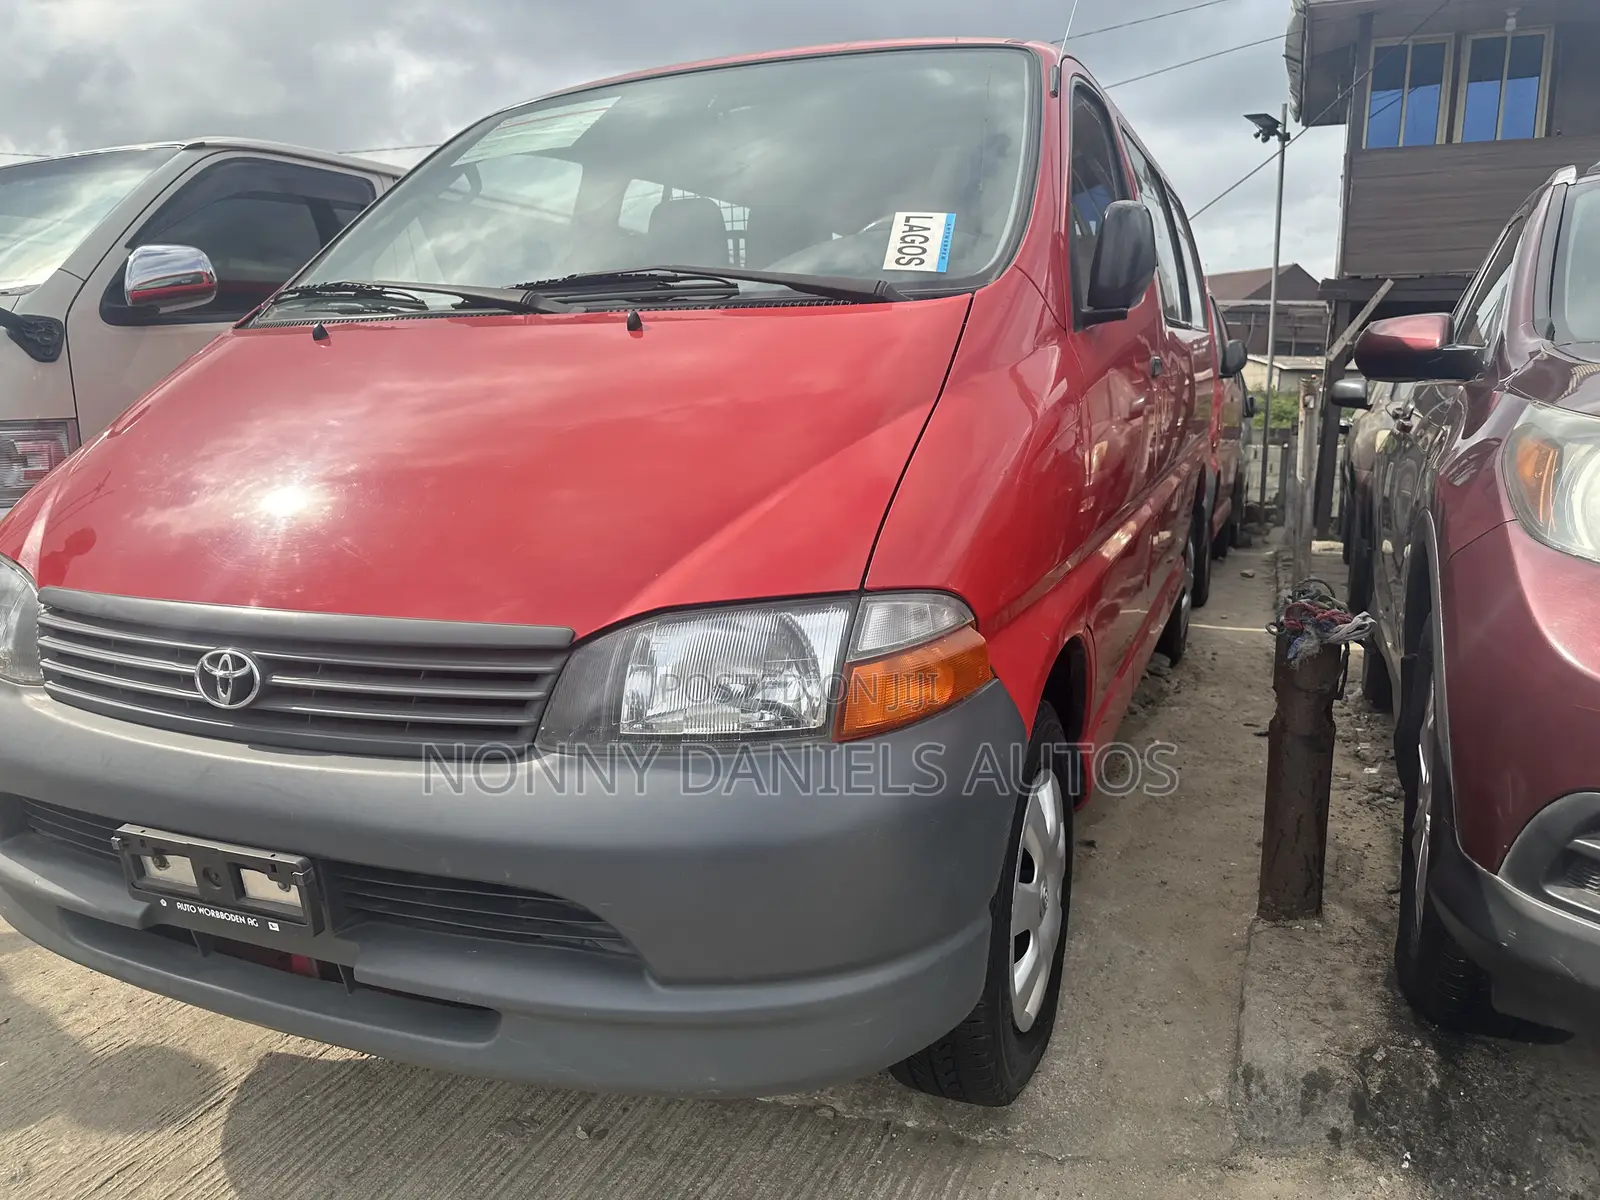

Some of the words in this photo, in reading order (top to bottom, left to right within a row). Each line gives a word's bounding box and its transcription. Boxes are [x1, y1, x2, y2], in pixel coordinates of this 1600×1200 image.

[895, 216, 933, 266] LAGOS
[176, 902, 196, 913] AUTO
[198, 907, 246, 924] WORBBODEN
[247, 918, 259, 927] AG
